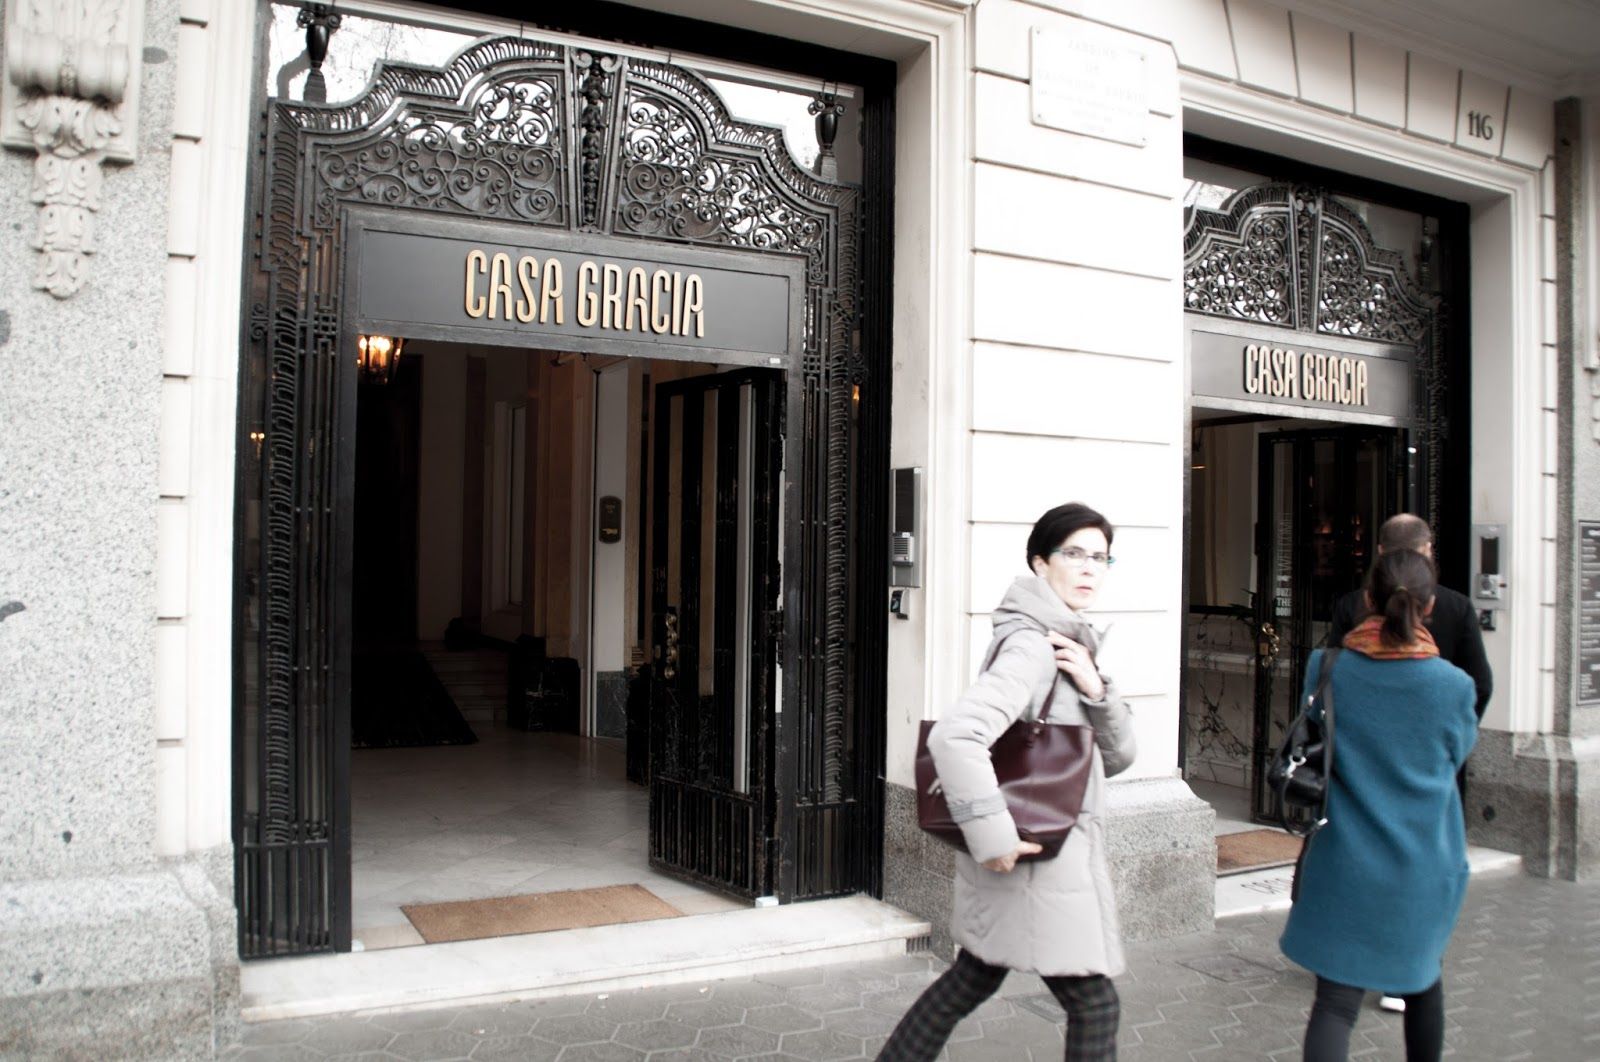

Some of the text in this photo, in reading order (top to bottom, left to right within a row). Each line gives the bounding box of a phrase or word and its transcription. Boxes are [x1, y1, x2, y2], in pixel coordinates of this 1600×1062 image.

[1468, 110, 1493, 140] 116
[465, 249, 705, 338] CASA GRACIA
[1244, 344, 1369, 406] CASA GRACIA
